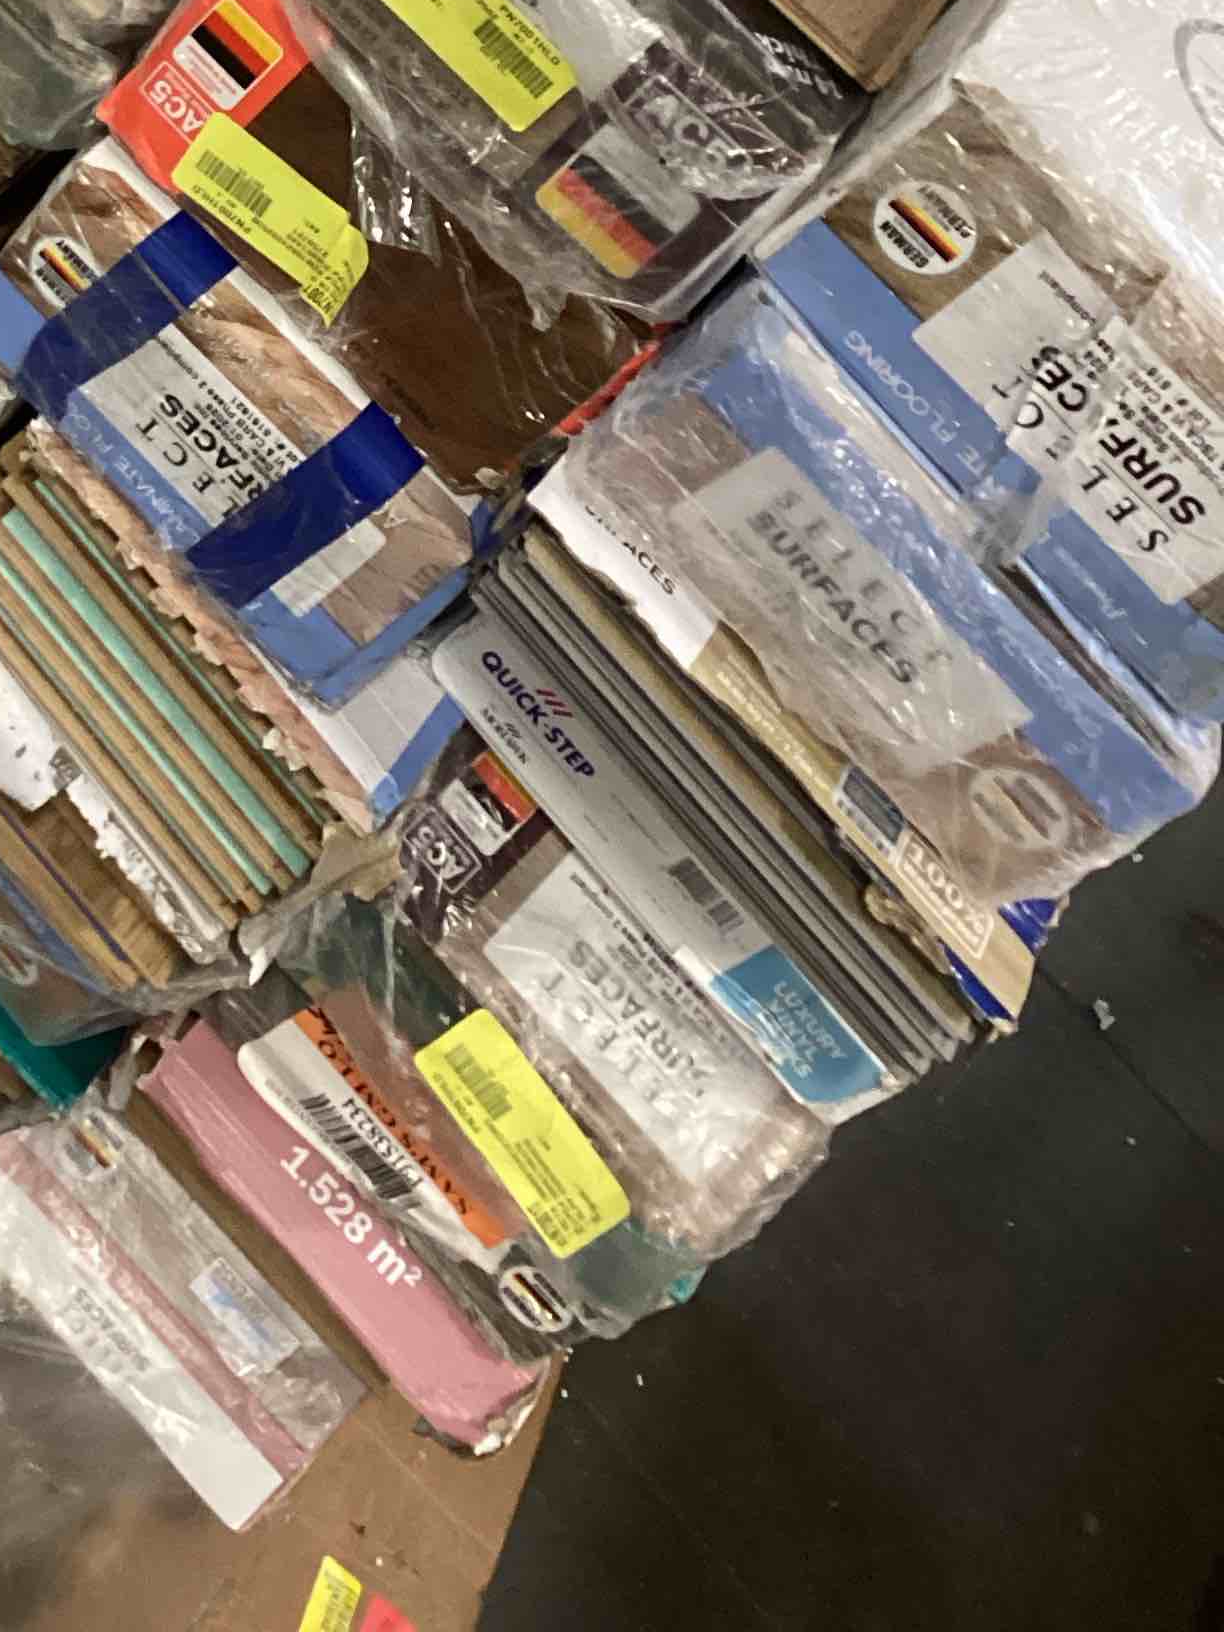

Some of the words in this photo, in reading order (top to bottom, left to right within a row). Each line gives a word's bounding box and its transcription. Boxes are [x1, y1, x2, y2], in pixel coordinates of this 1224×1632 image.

[149, 77, 203, 135] AC5
[197, 380, 205, 388] 2
[206, 387, 236, 419] Phase
[235, 417, 265, 448] CARB
[843, 326, 956, 446] FLOORING
[1025, 341, 1207, 533] SURFCES
[135, 410, 238, 521] LECT
[156, 388, 265, 505] RFACES
[988, 368, 1170, 559] SELCT
[745, 511, 915, 684] SURFACES
[481, 650, 596, 780] QUICK-STEP
[771, 982, 852, 1061] LUXURY
[337, 1096, 427, 1188] P91538234
[280, 1145, 372, 1243] 1.528
[368, 1238, 424, 1290] m²
